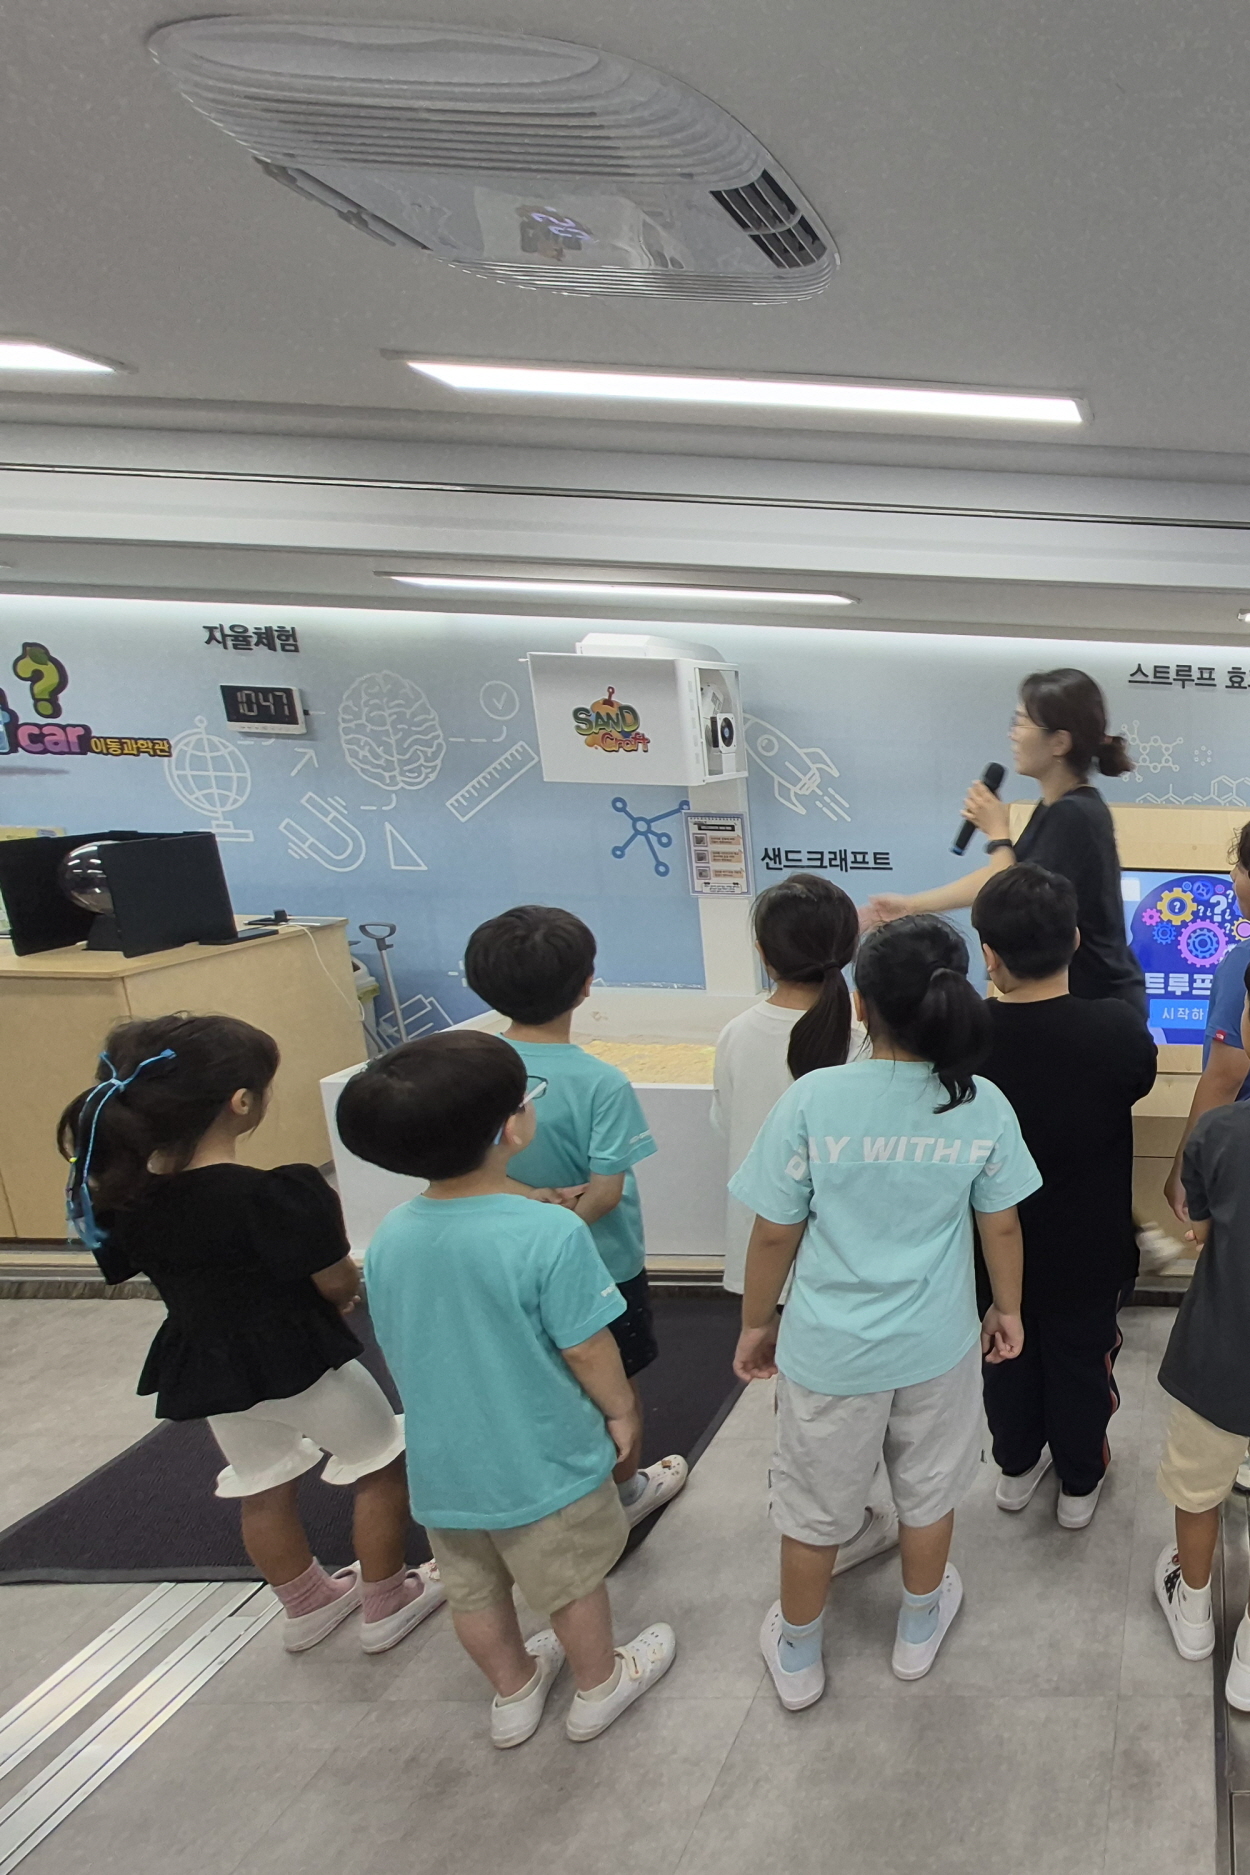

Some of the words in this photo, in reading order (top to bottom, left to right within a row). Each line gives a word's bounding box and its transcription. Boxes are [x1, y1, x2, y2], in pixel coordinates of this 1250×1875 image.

[202, 623, 300, 652] 자율체험
[1128, 663, 1217, 689] 스트루프
[572, 703, 640, 736] SAND
[91, 737, 171, 756] 이동과학관
[600, 731, 650, 752] Craft
[761, 847, 893, 872] 샌드크래프트
[1144, 972, 1214, 996] 트루프
[863, 1136, 961, 1165] WITH
